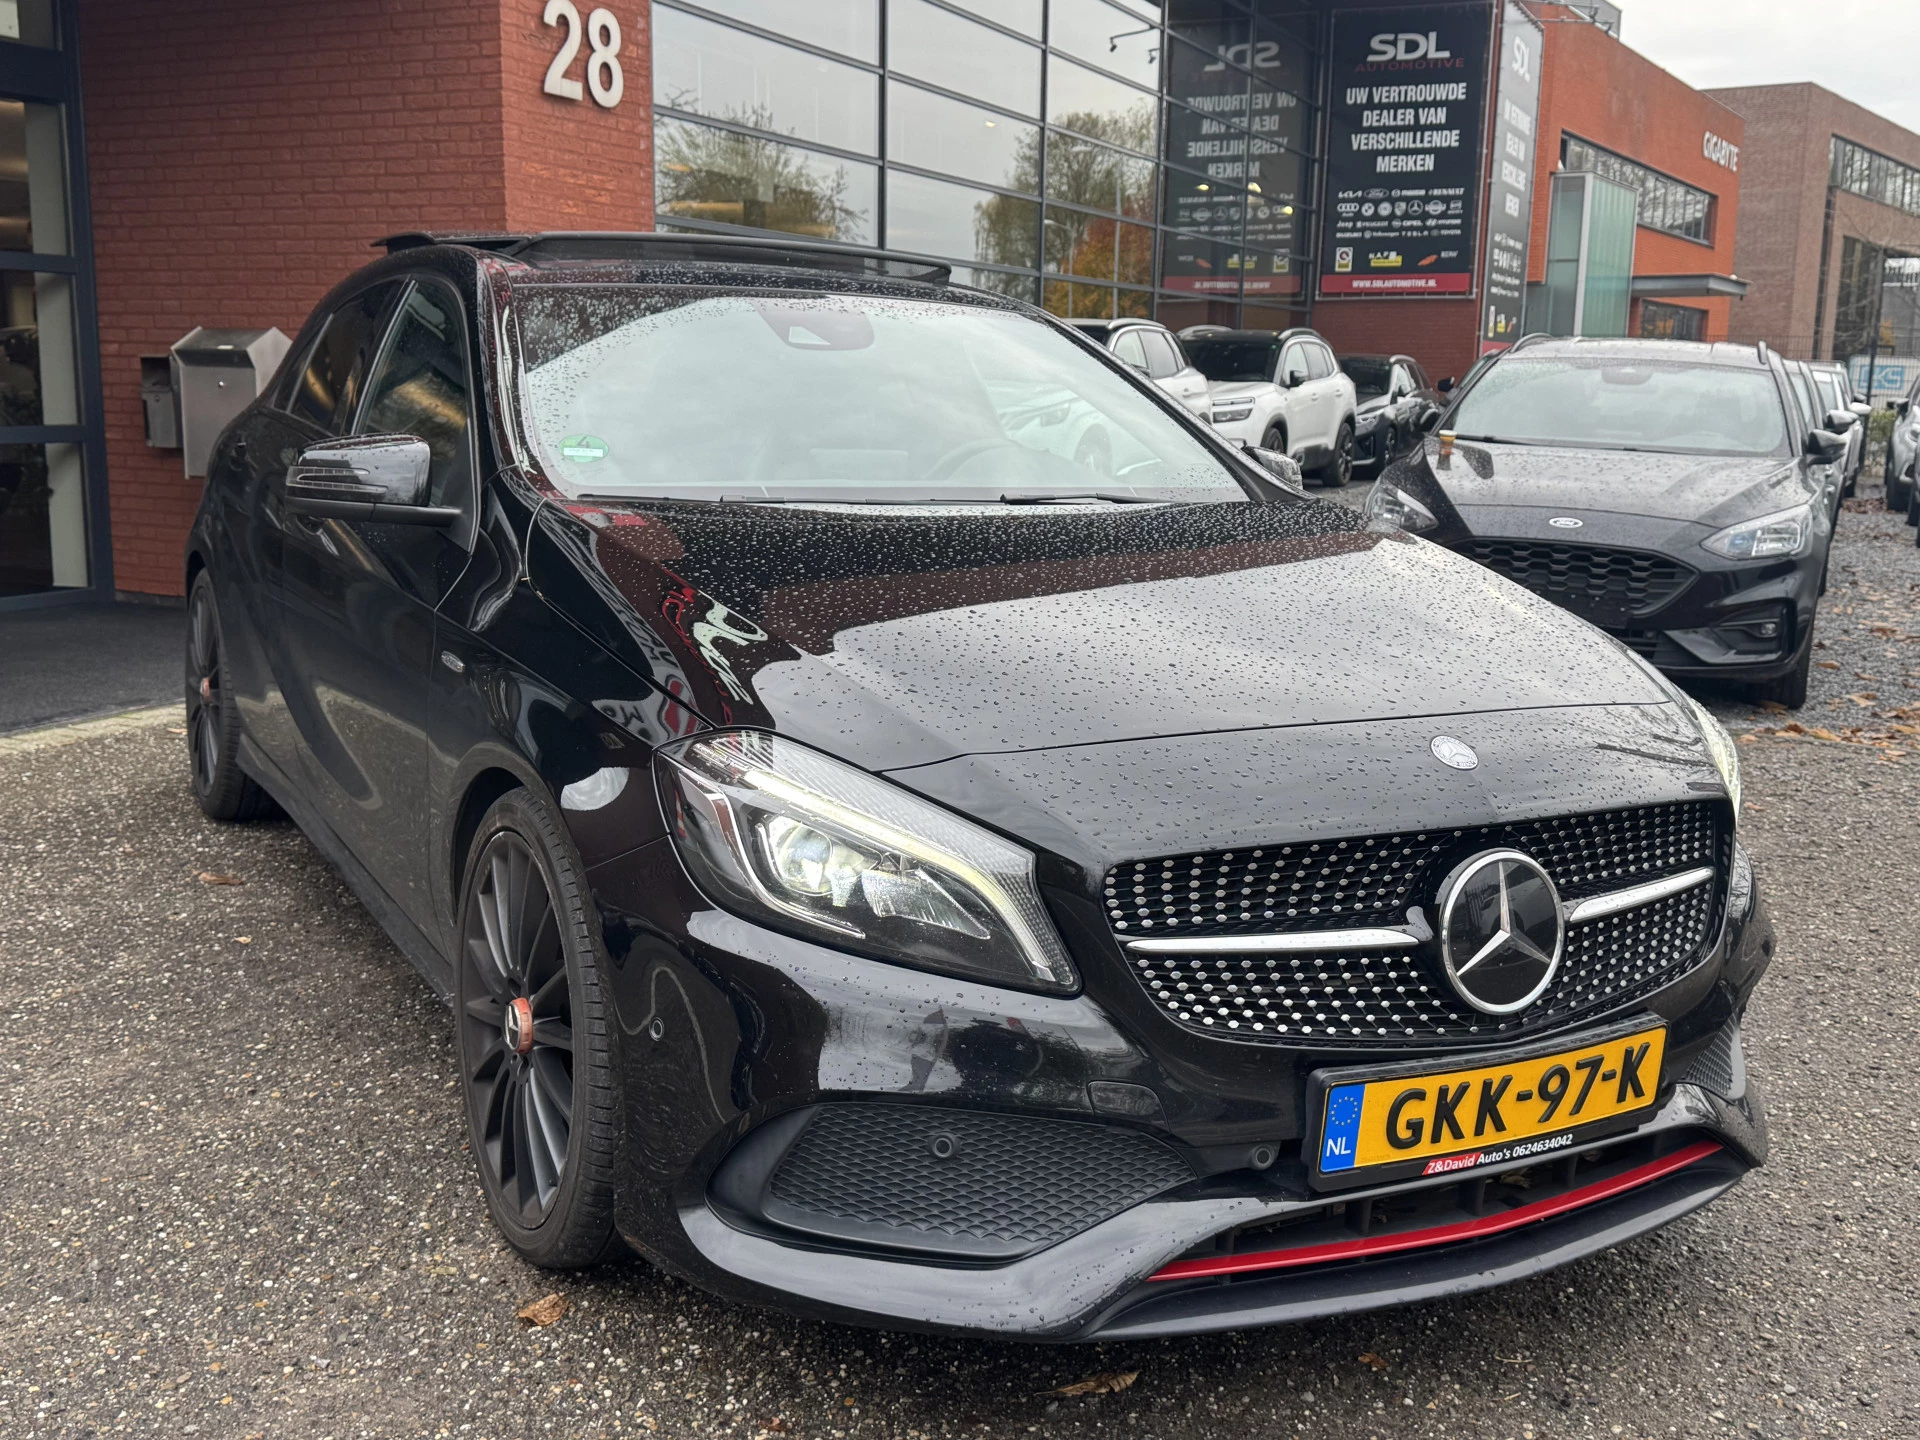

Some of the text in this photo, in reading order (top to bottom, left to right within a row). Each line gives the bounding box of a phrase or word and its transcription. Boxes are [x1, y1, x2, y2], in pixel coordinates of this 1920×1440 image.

[543, 0, 624, 108] 28
[1366, 31, 1451, 62] SDL
[1355, 58, 1465, 73] AUTOMOTIVE
[1346, 83, 1467, 105] UW VERTROUWDE
[1362, 107, 1447, 127] DEALER VAN
[1351, 130, 1460, 151] VERSCHILLENDE
[1376, 154, 1435, 173] MERKEN
[1385, 1041, 1651, 1150] GKK-97-K
[1326, 1136, 1352, 1157] NL
[1427, 1133, 1574, 1174] Z&David Auto's 0624634042
